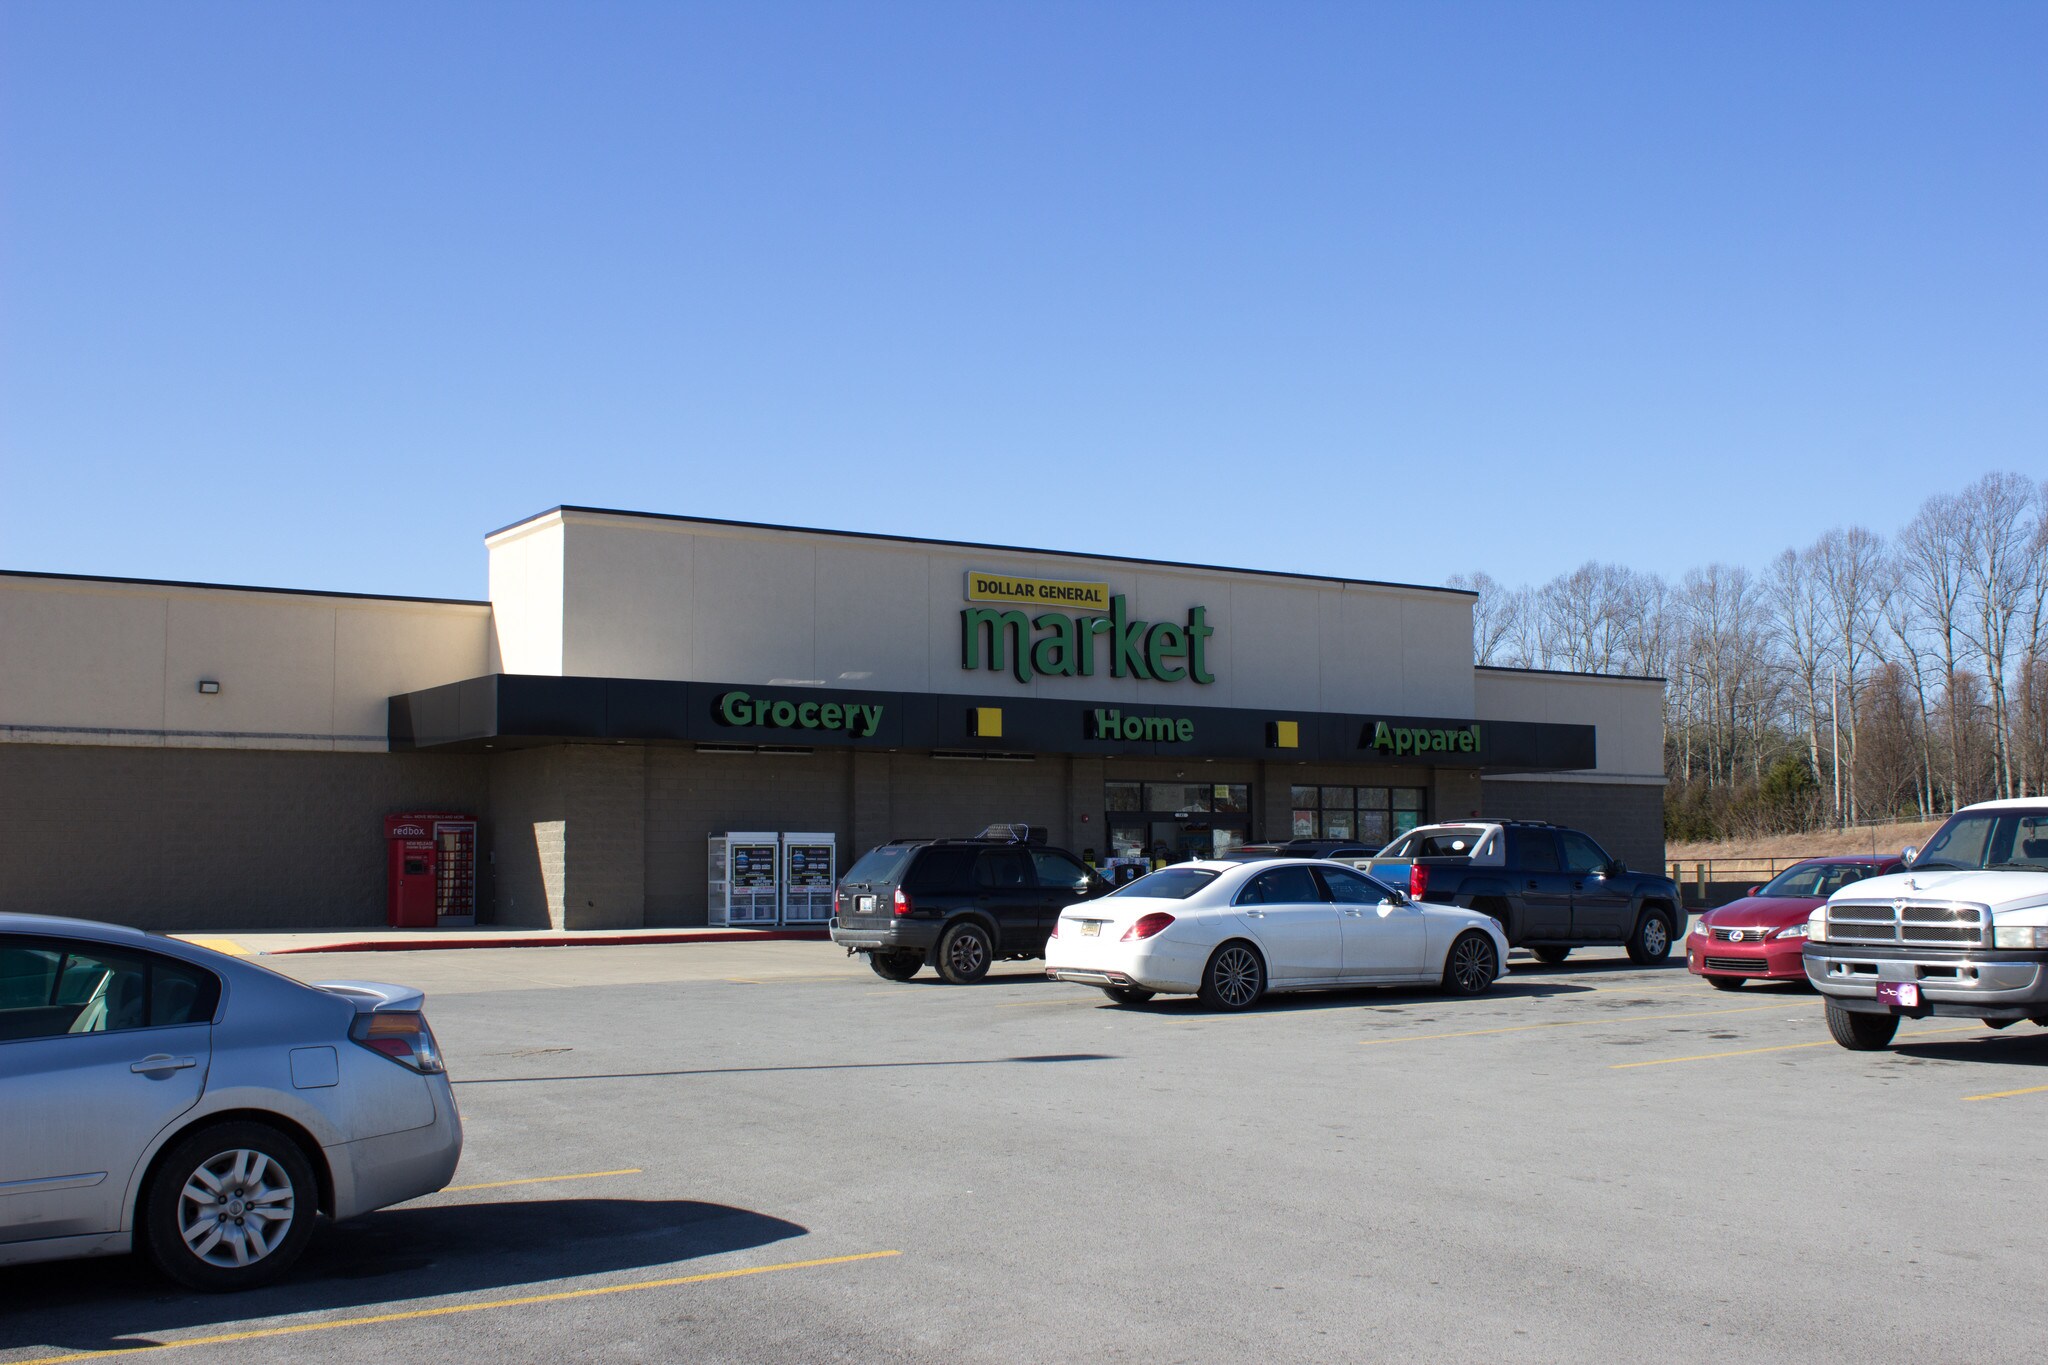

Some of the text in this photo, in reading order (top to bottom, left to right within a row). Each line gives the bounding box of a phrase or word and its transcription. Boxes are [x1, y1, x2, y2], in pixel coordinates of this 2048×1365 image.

[977, 580, 1102, 603] DOLLAR GENERAL
[960, 594, 1215, 685] market
[721, 691, 884, 738] Grocery
[1094, 708, 1195, 742] Home
[1372, 721, 1481, 756] Apparel
[393, 826, 425, 836] redbox
